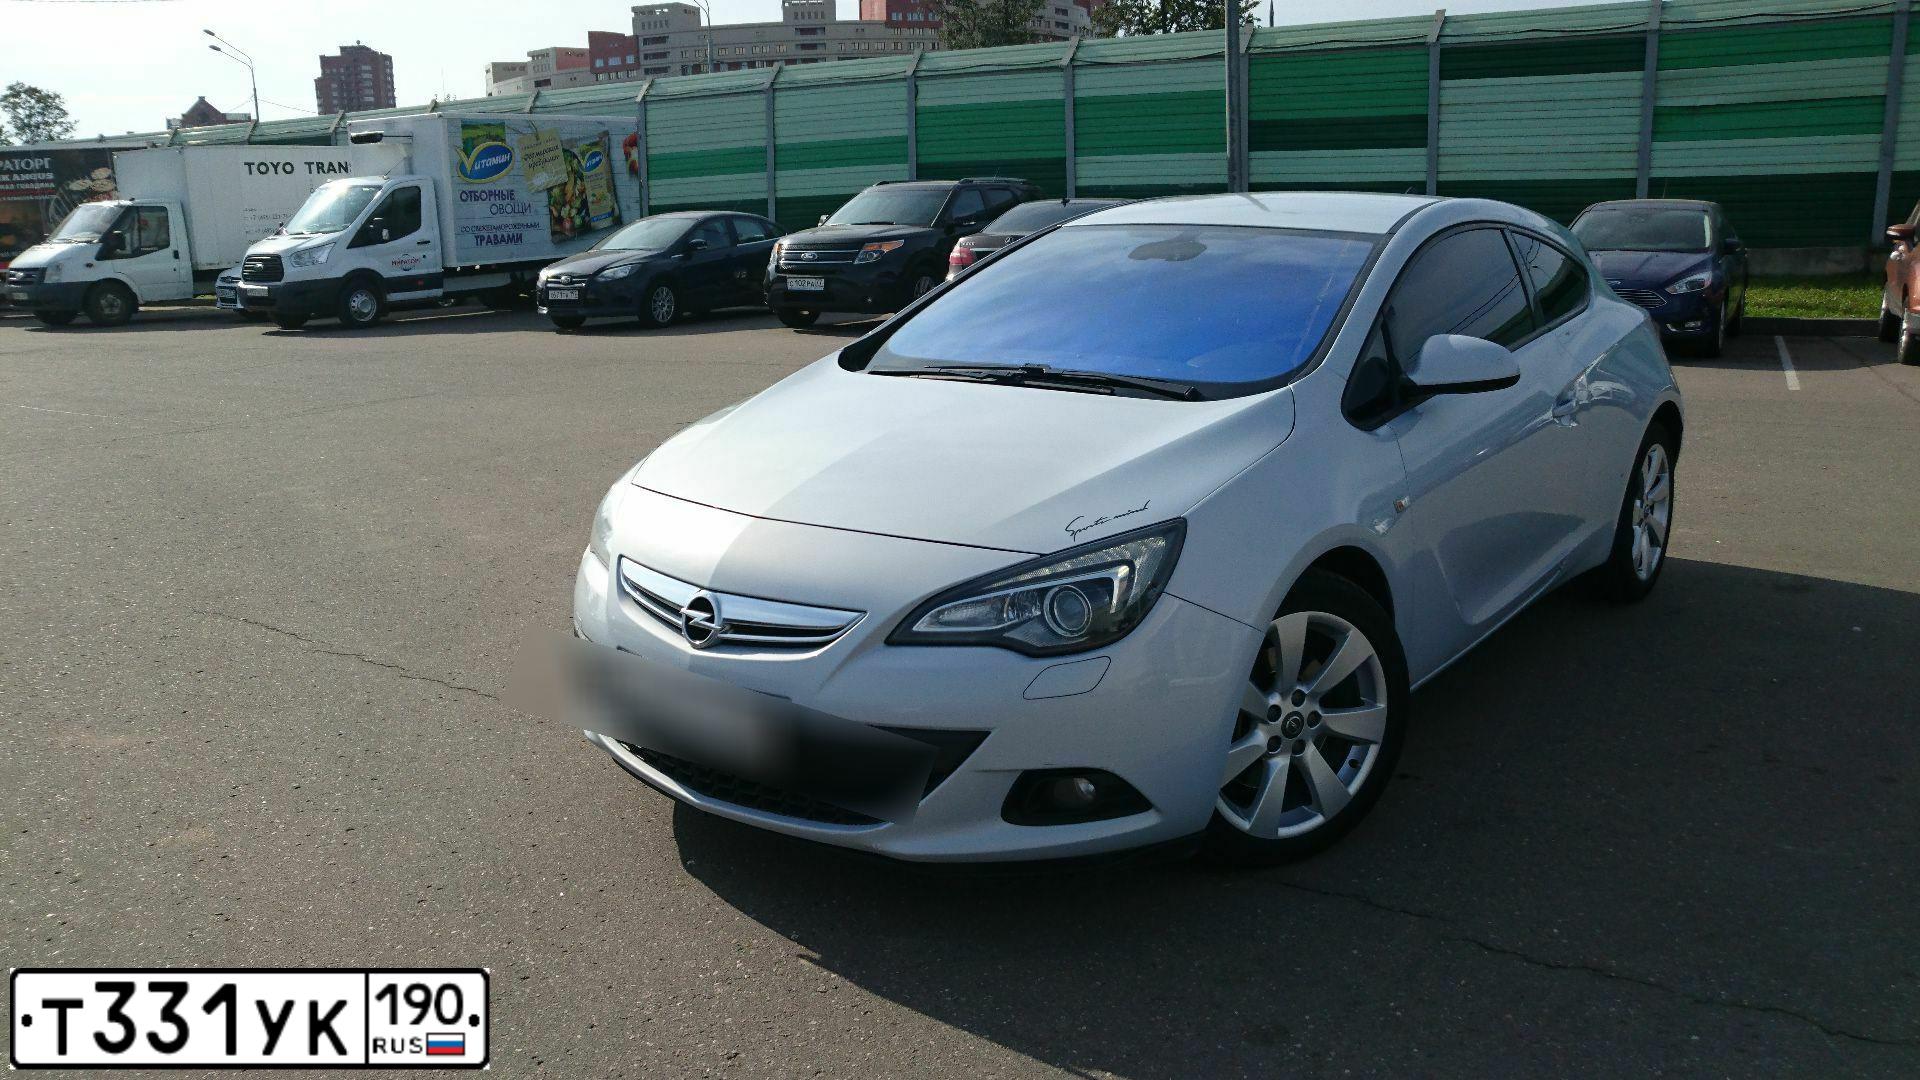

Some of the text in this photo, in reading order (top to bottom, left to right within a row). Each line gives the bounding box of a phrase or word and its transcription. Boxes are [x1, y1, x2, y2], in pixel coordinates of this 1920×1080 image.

[244, 160, 352, 175] TOYO TRAN
[12, 172, 54, 181] ANGUS
[460, 189, 516, 202] ОТБОРНЫЕ
[490, 203, 532, 216] ОВОЩИ
[474, 233, 523, 246] ТРАВАМИ
